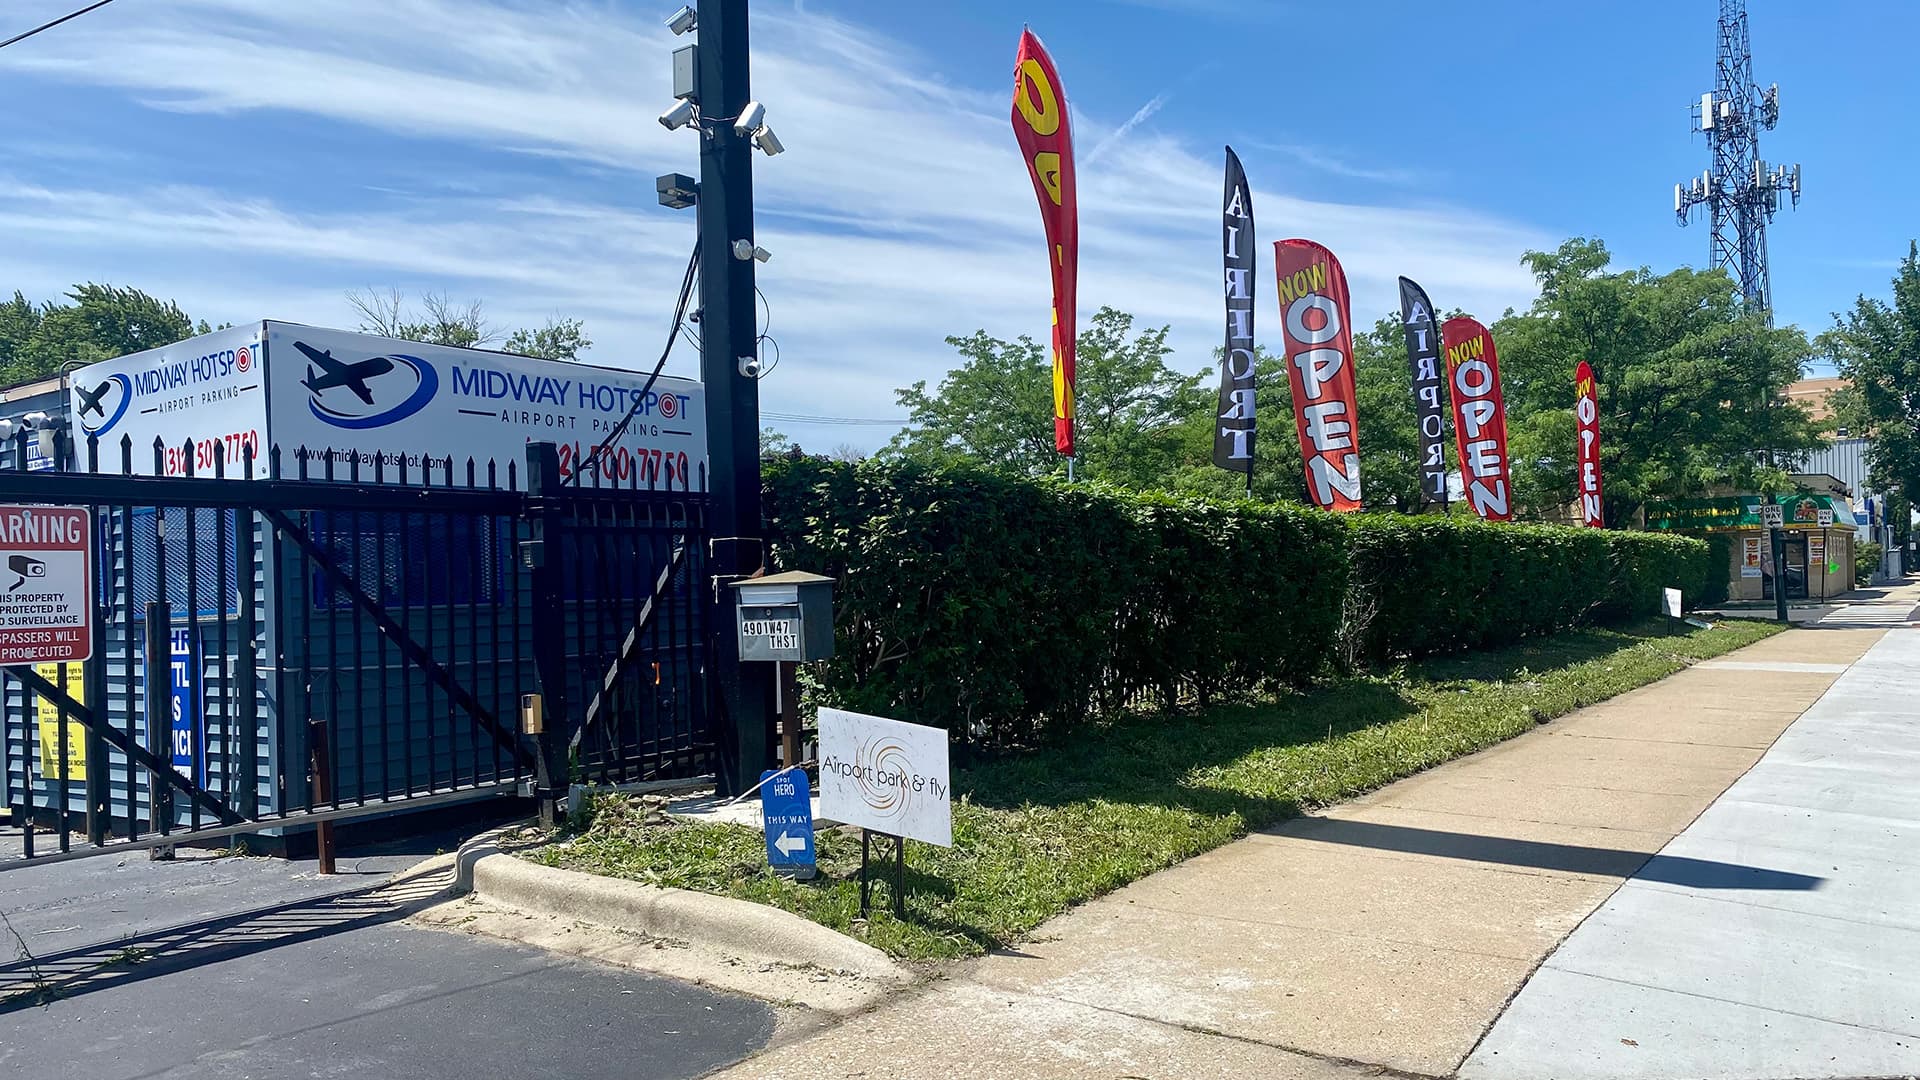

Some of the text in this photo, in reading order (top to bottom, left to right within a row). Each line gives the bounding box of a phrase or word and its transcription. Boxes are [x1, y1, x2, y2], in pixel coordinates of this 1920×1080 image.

[1279, 262, 1326, 306] NOW
[1449, 335, 1484, 367] NOW
[134, 361, 188, 397] MIDWAY
[451, 366, 572, 406] MIDWAY
[159, 385, 239, 414] AIRPORT PARKING
[1286, 293, 1362, 506] OPEN
[501, 409, 659, 437] AIRPORT PARKING
[1455, 358, 1509, 518] OPEN
[197, 437, 220, 470] 50
[293, 447, 447, 470] wwwmidayotsot.om
[1577, 395, 1600, 524] OPEN
[1764, 505, 1781, 514] ONE
[1765, 512, 1782, 520] WAY
[0, 604, 69, 614] PROTECTED BY
[15, 593, 65, 603] PROPERTY
[8, 615, 79, 626] SURVEILLANCE
[0, 630, 80, 644] PASSERS WILL
[774, 784, 795, 797] HERO
[822, 755, 947, 801] Airport park & fly
[767, 815, 808, 825] THIS WAY
